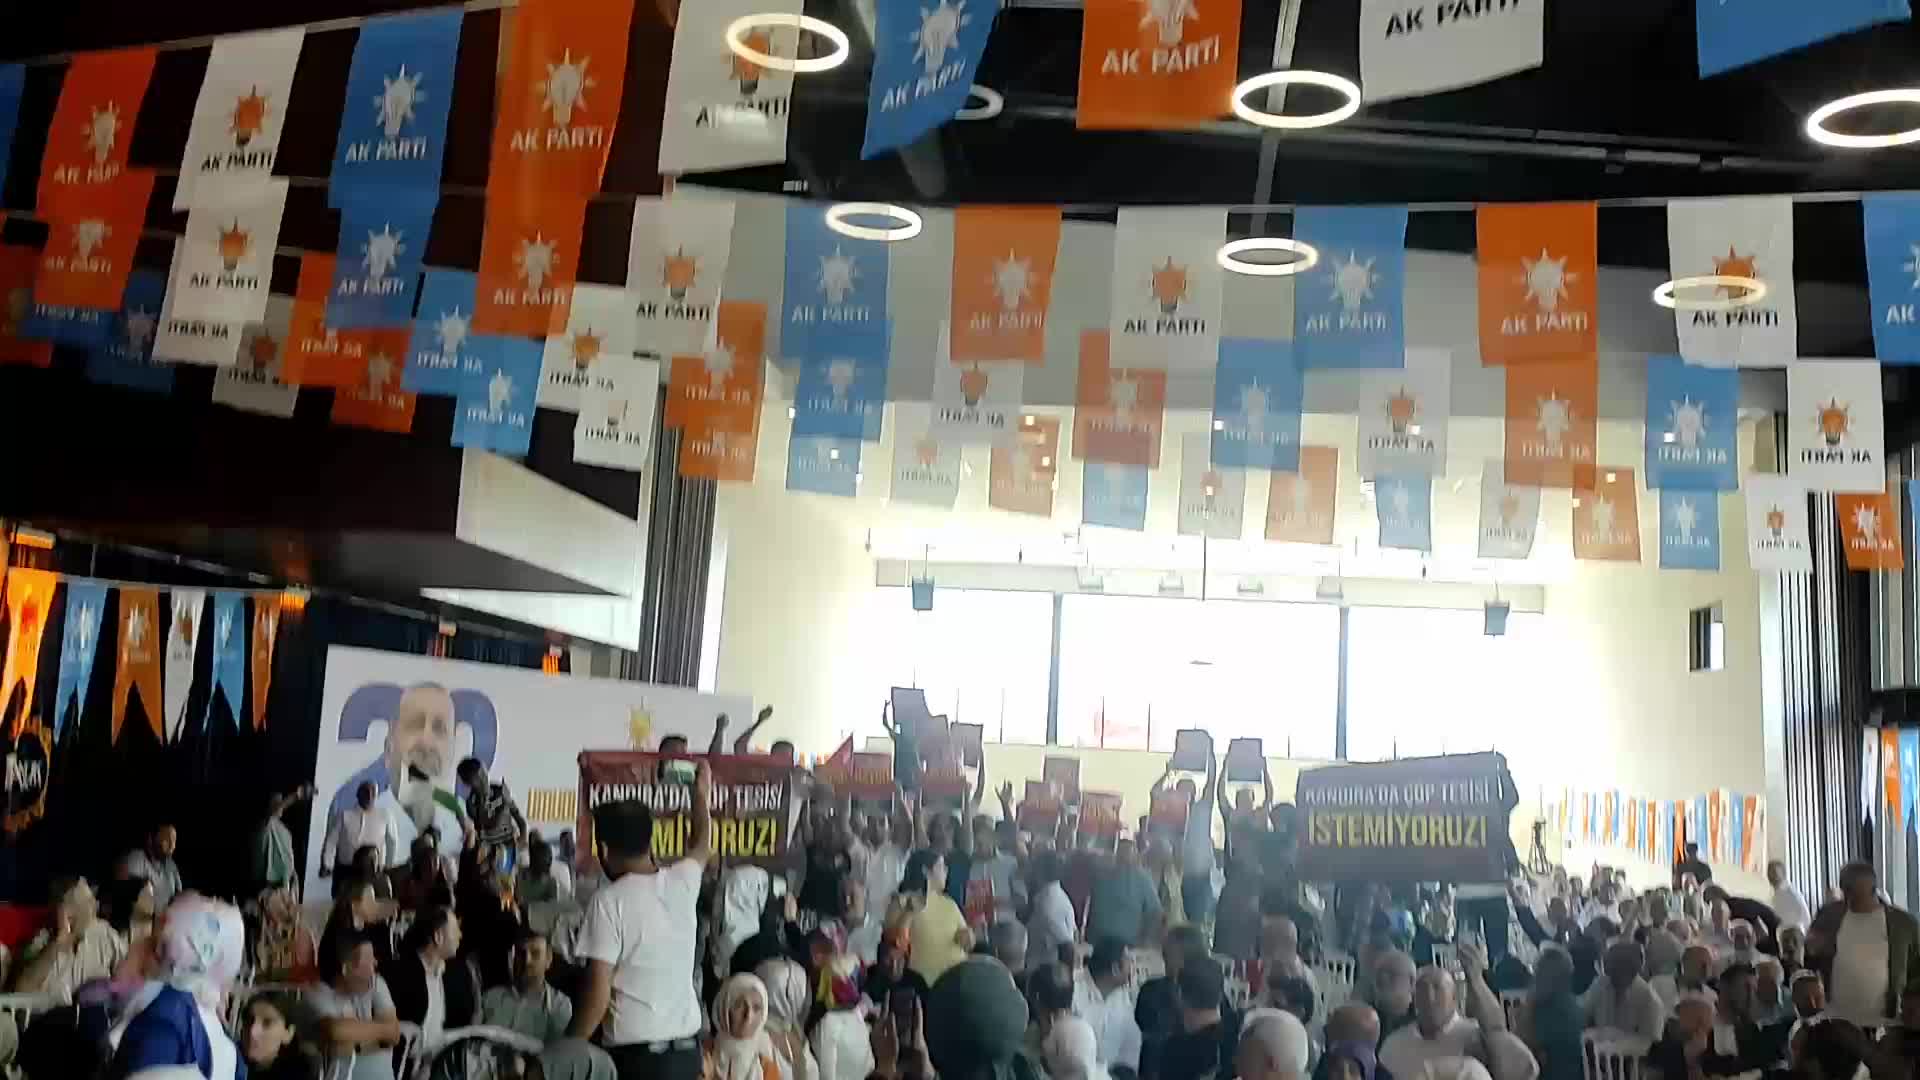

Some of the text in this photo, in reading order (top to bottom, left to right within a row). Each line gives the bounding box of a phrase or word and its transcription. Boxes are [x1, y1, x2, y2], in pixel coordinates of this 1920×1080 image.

[1384, 7, 1422, 39] AK
[1101, 48, 1138, 75] AK
[881, 82, 909, 113] AK
[511, 131, 538, 152] AK
[346, 143, 370, 163] AK
[201, 154, 222, 172] AK
[190, 274, 210, 290] AK
[338, 279, 358, 295] AK
[494, 290, 516, 305] AK
[636, 303, 659, 320] AK
[792, 305, 815, 322] AK
[1692, 310, 1718, 328] AK
[1886, 304, 1915, 324] AK
[1124, 318, 1149, 334] AK
[1306, 313, 1330, 331] AK
[1500, 315, 1527, 336] AK
